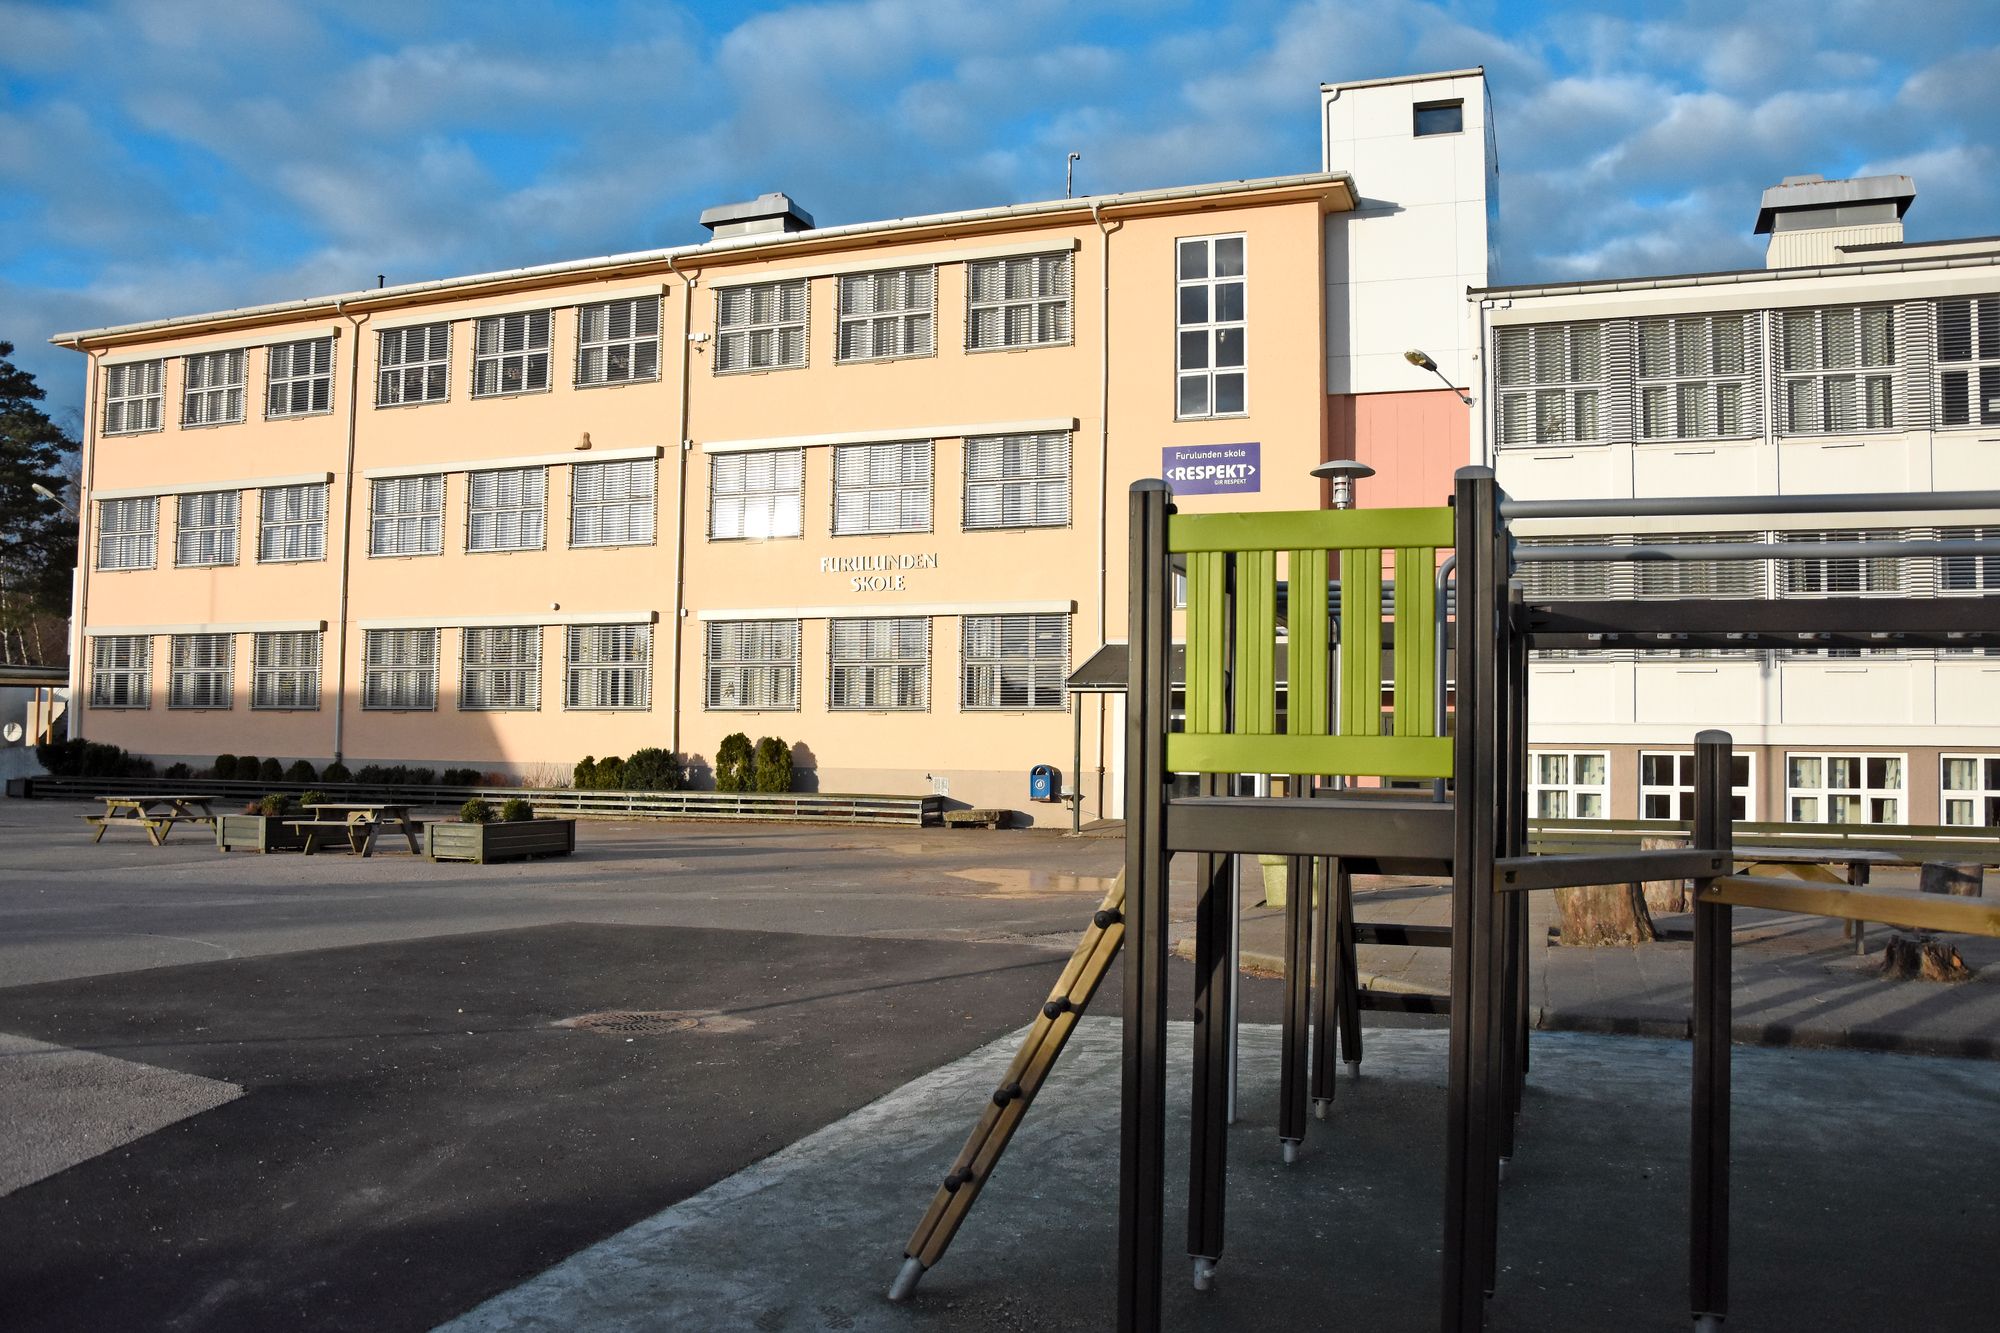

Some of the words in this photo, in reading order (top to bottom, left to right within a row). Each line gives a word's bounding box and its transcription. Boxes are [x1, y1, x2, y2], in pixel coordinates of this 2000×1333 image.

[1175, 451, 1222, 460] Furulunden
[1224, 450, 1246, 458] skole
[819, 553, 938, 573] FURULUNDEN
[850, 575, 906, 592] SKOLE
